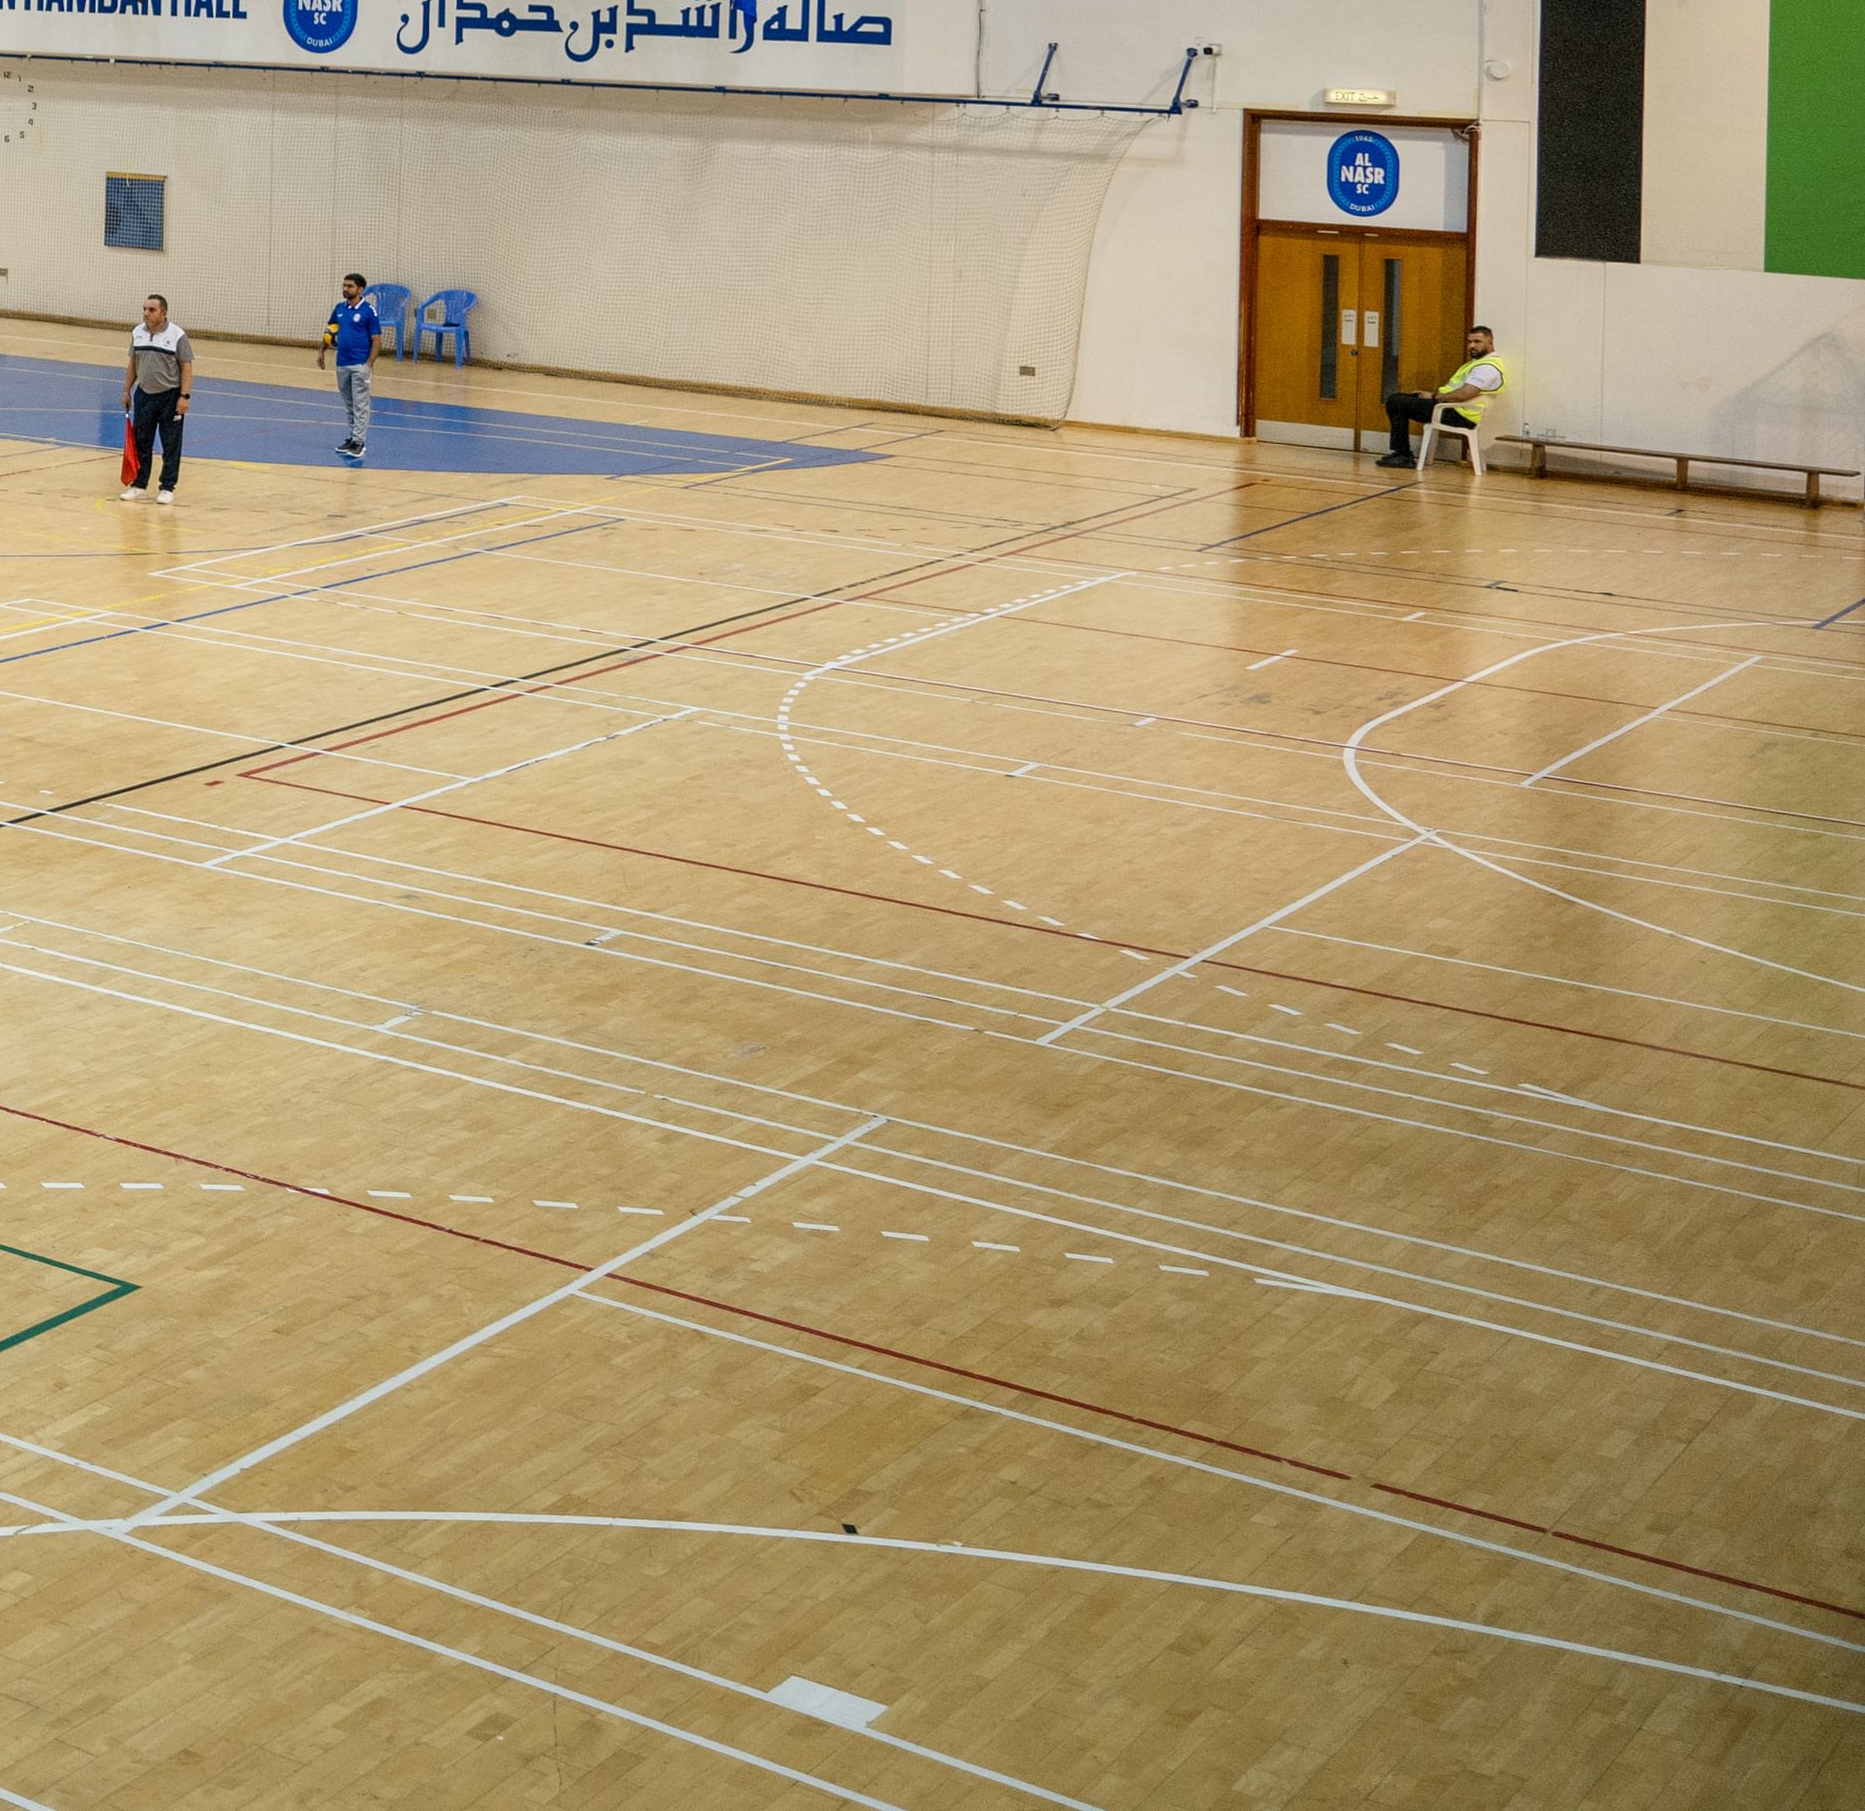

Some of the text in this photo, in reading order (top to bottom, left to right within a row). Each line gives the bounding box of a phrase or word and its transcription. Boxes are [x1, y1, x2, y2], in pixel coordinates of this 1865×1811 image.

[313, 12, 327, 25] SC
[306, 37, 333, 47] DUBAI
[1335, 91, 1356, 101] EXIT
[1354, 152, 1372, 167] AL
[1340, 165, 1385, 185] NASR
[1356, 183, 1369, 194] SC
